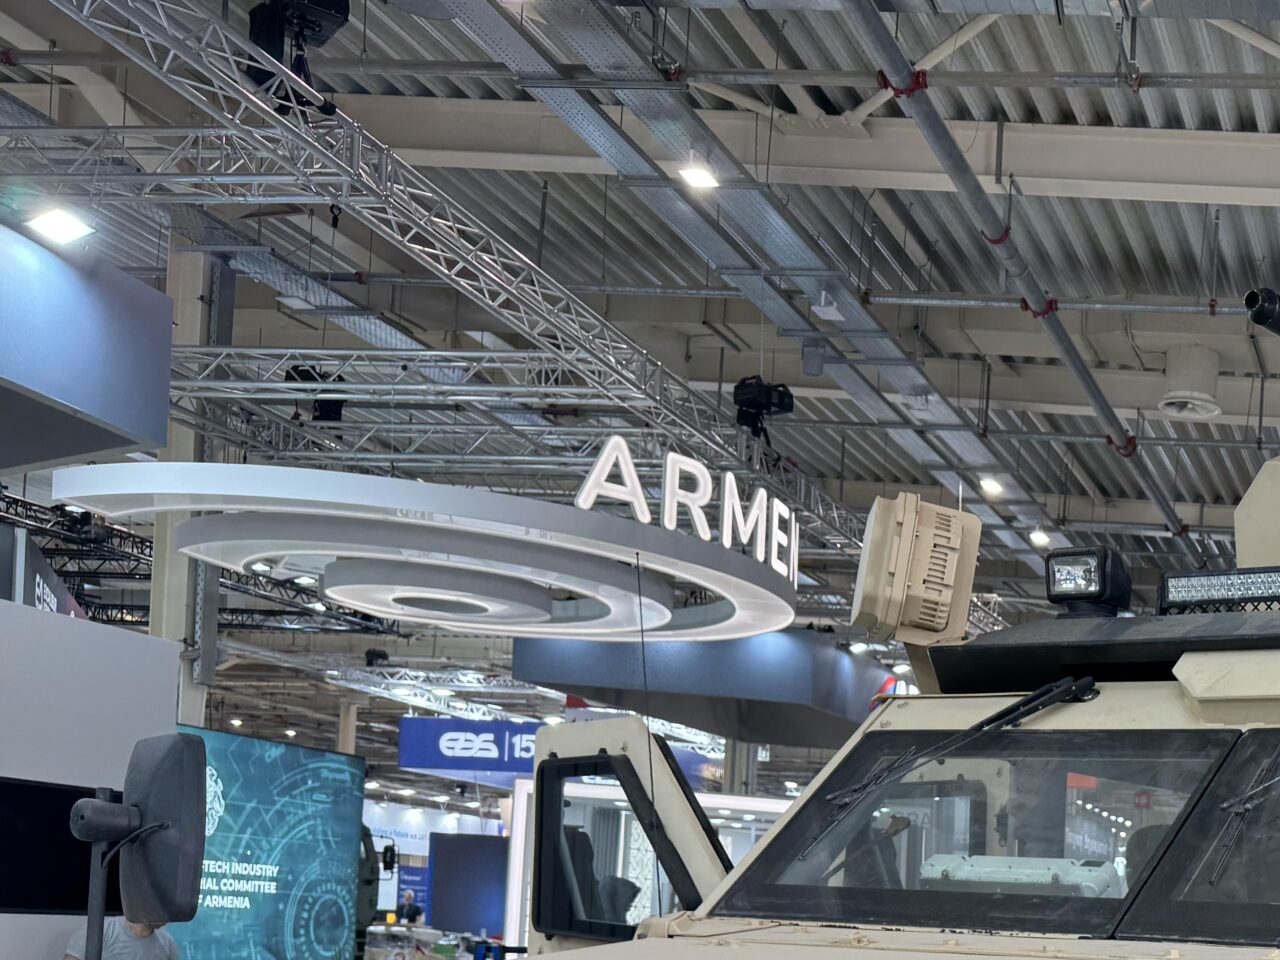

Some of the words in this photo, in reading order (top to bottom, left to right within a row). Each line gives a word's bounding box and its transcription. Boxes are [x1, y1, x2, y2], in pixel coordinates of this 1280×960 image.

[231, 862, 279, 877] INDUSTRY
[220, 879, 277, 893] COMMITTEE
[204, 895, 250, 908] ARMENIA
